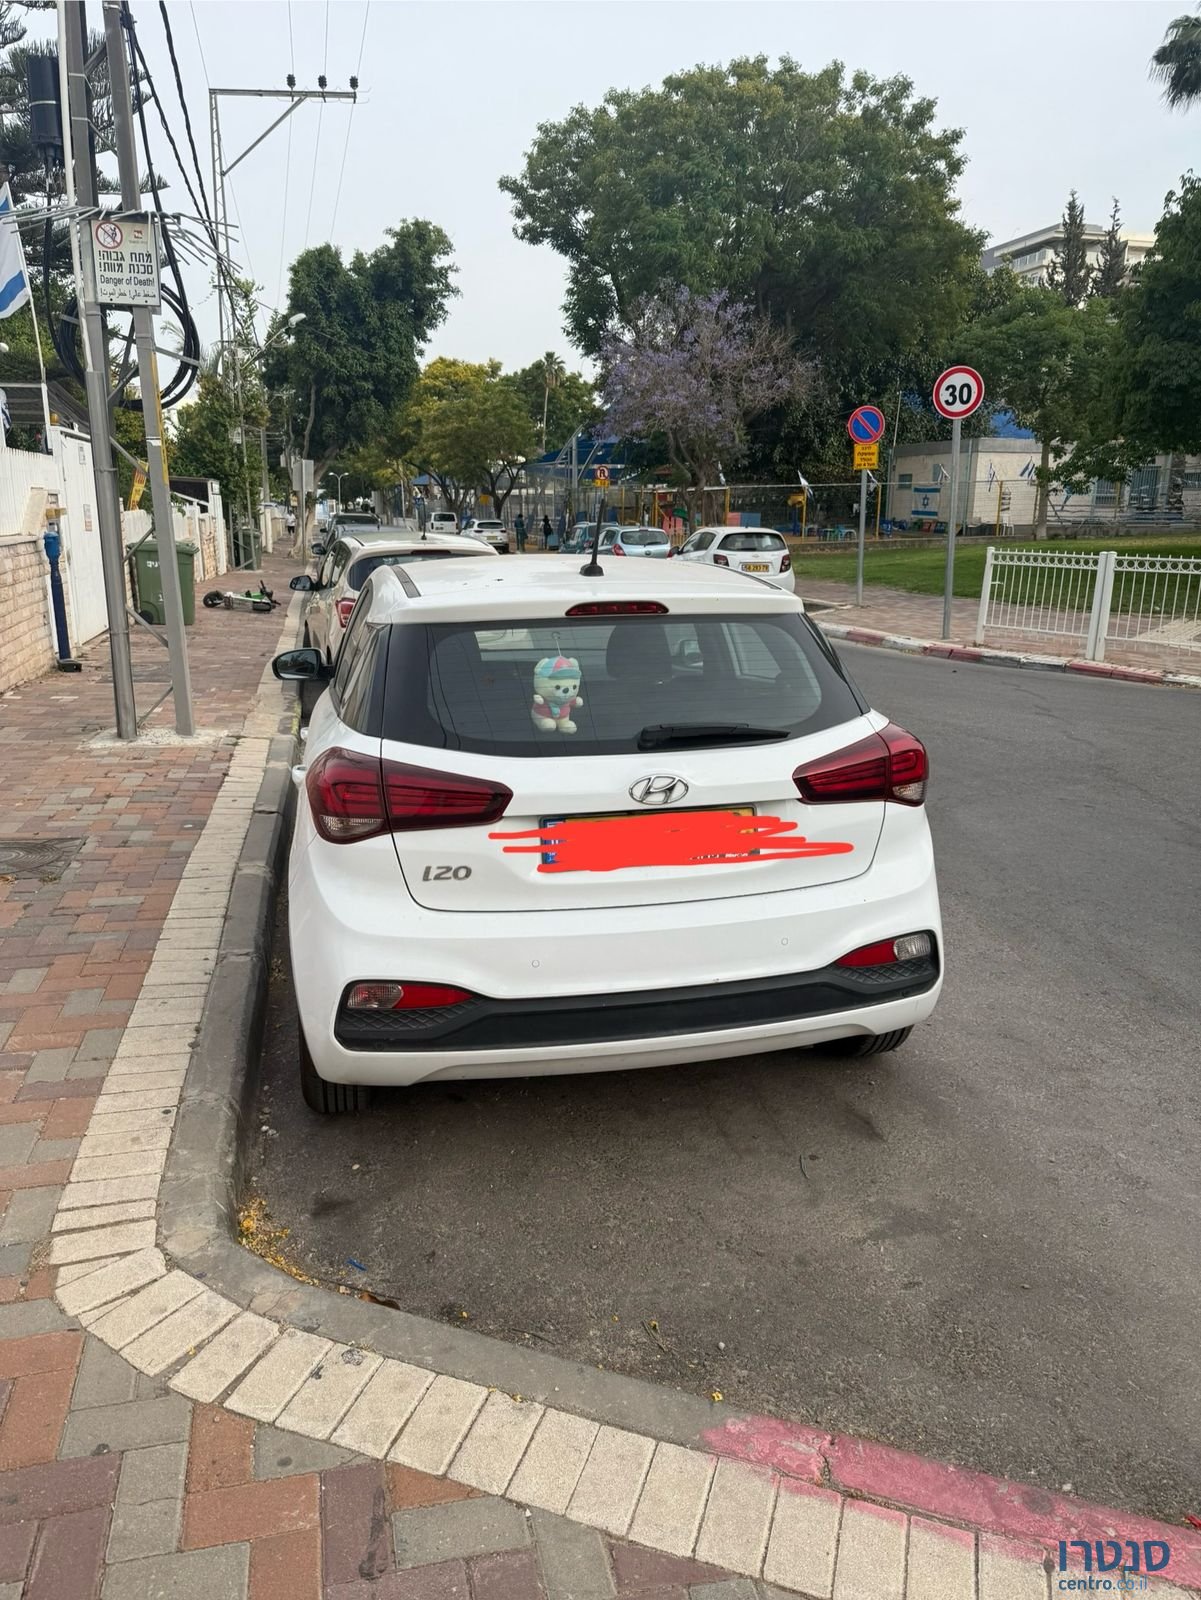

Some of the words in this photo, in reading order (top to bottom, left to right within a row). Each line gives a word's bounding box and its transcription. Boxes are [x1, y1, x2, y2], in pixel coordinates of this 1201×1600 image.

[99, 250, 125, 262] גבוה!
[130, 252, 152, 263] מתח
[99, 262, 123, 273] מוות!
[128, 264, 153, 274] סכנת
[100, 274, 124, 287] Danger
[125, 276, 132, 285] of
[133, 276, 155, 287] Death!
[944, 383, 972, 406] 30
